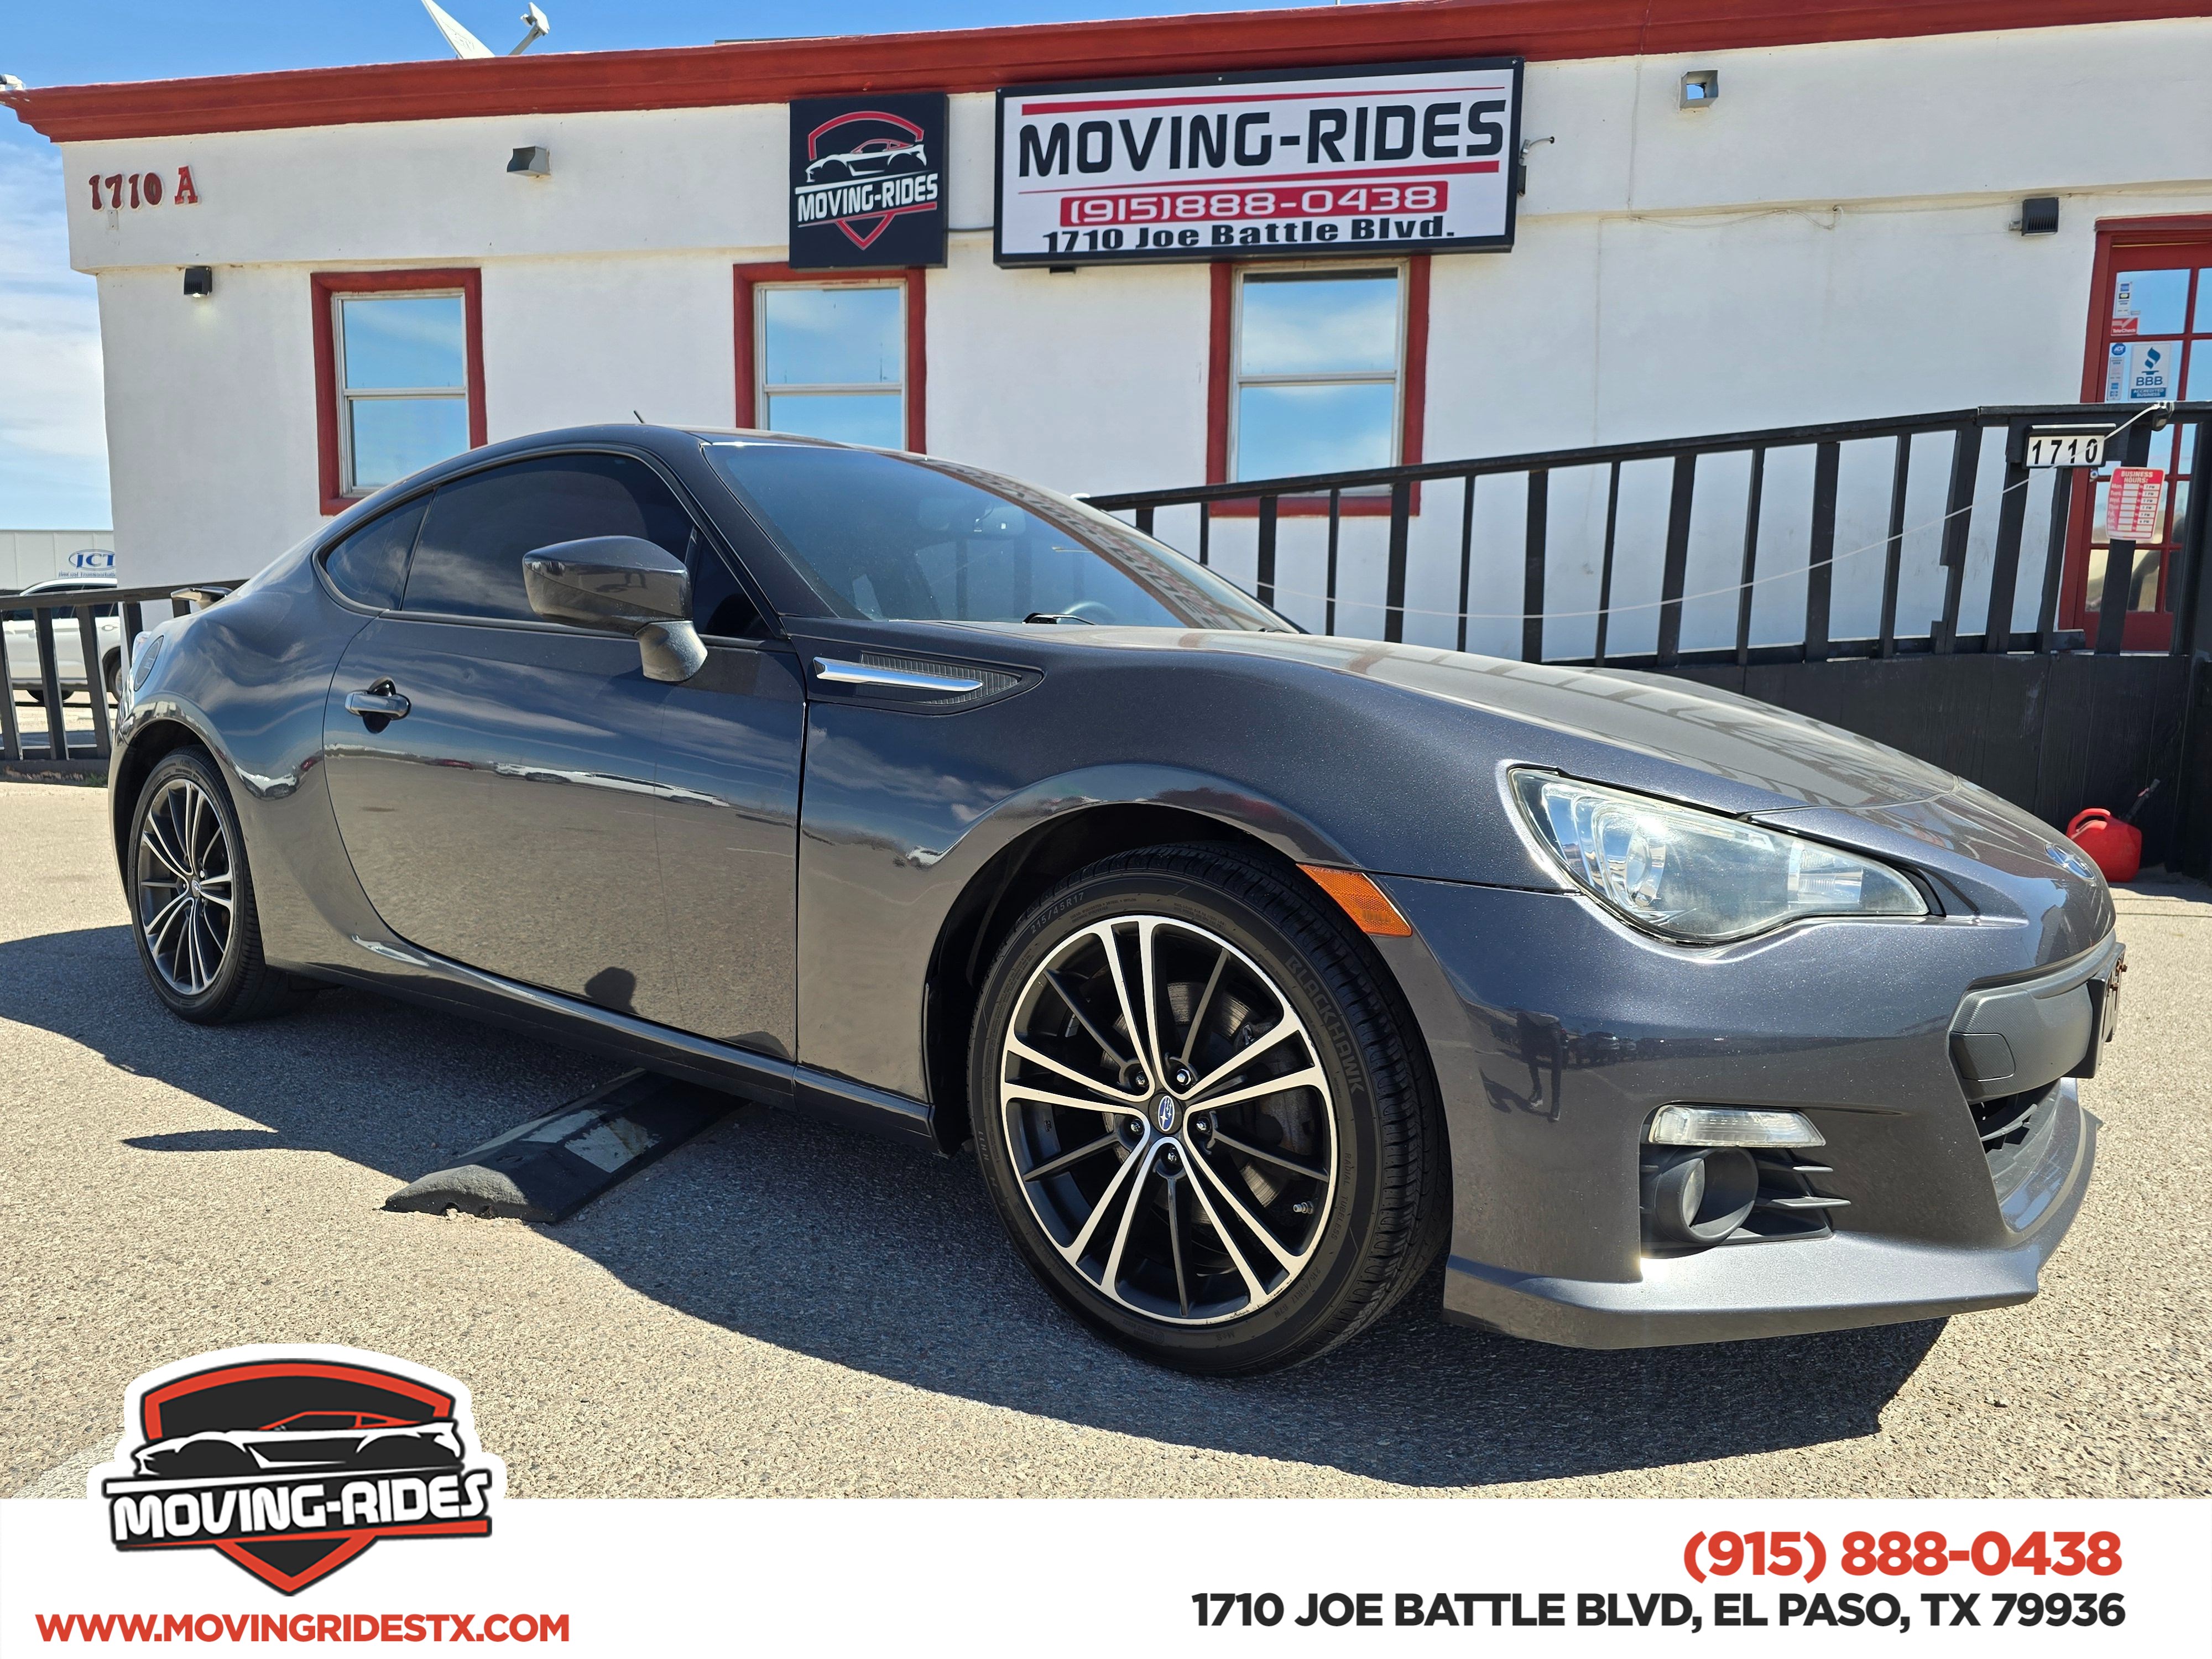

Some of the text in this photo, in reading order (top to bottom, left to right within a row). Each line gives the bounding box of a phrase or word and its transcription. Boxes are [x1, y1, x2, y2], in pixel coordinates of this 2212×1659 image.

[1018, 100, 1505, 178] MOVING-RIDES
[88, 165, 198, 210] 1710 A
[797, 173, 938, 222] MOVING-RIDES
[1070, 186, 1437, 224] (915)888-0438
[1042, 216, 1454, 253] 1710 Joe Battle Blvd.
[2136, 376, 2163, 386] BBB
[2032, 438, 2098, 465] 1710
[76, 553, 115, 568] JCT
[1031, 891, 1084, 935] 215/45R17
[1287, 956, 1364, 1094] BLACKHAWK
[1331, 1152, 1352, 1240] RADIAL TUBELESS
